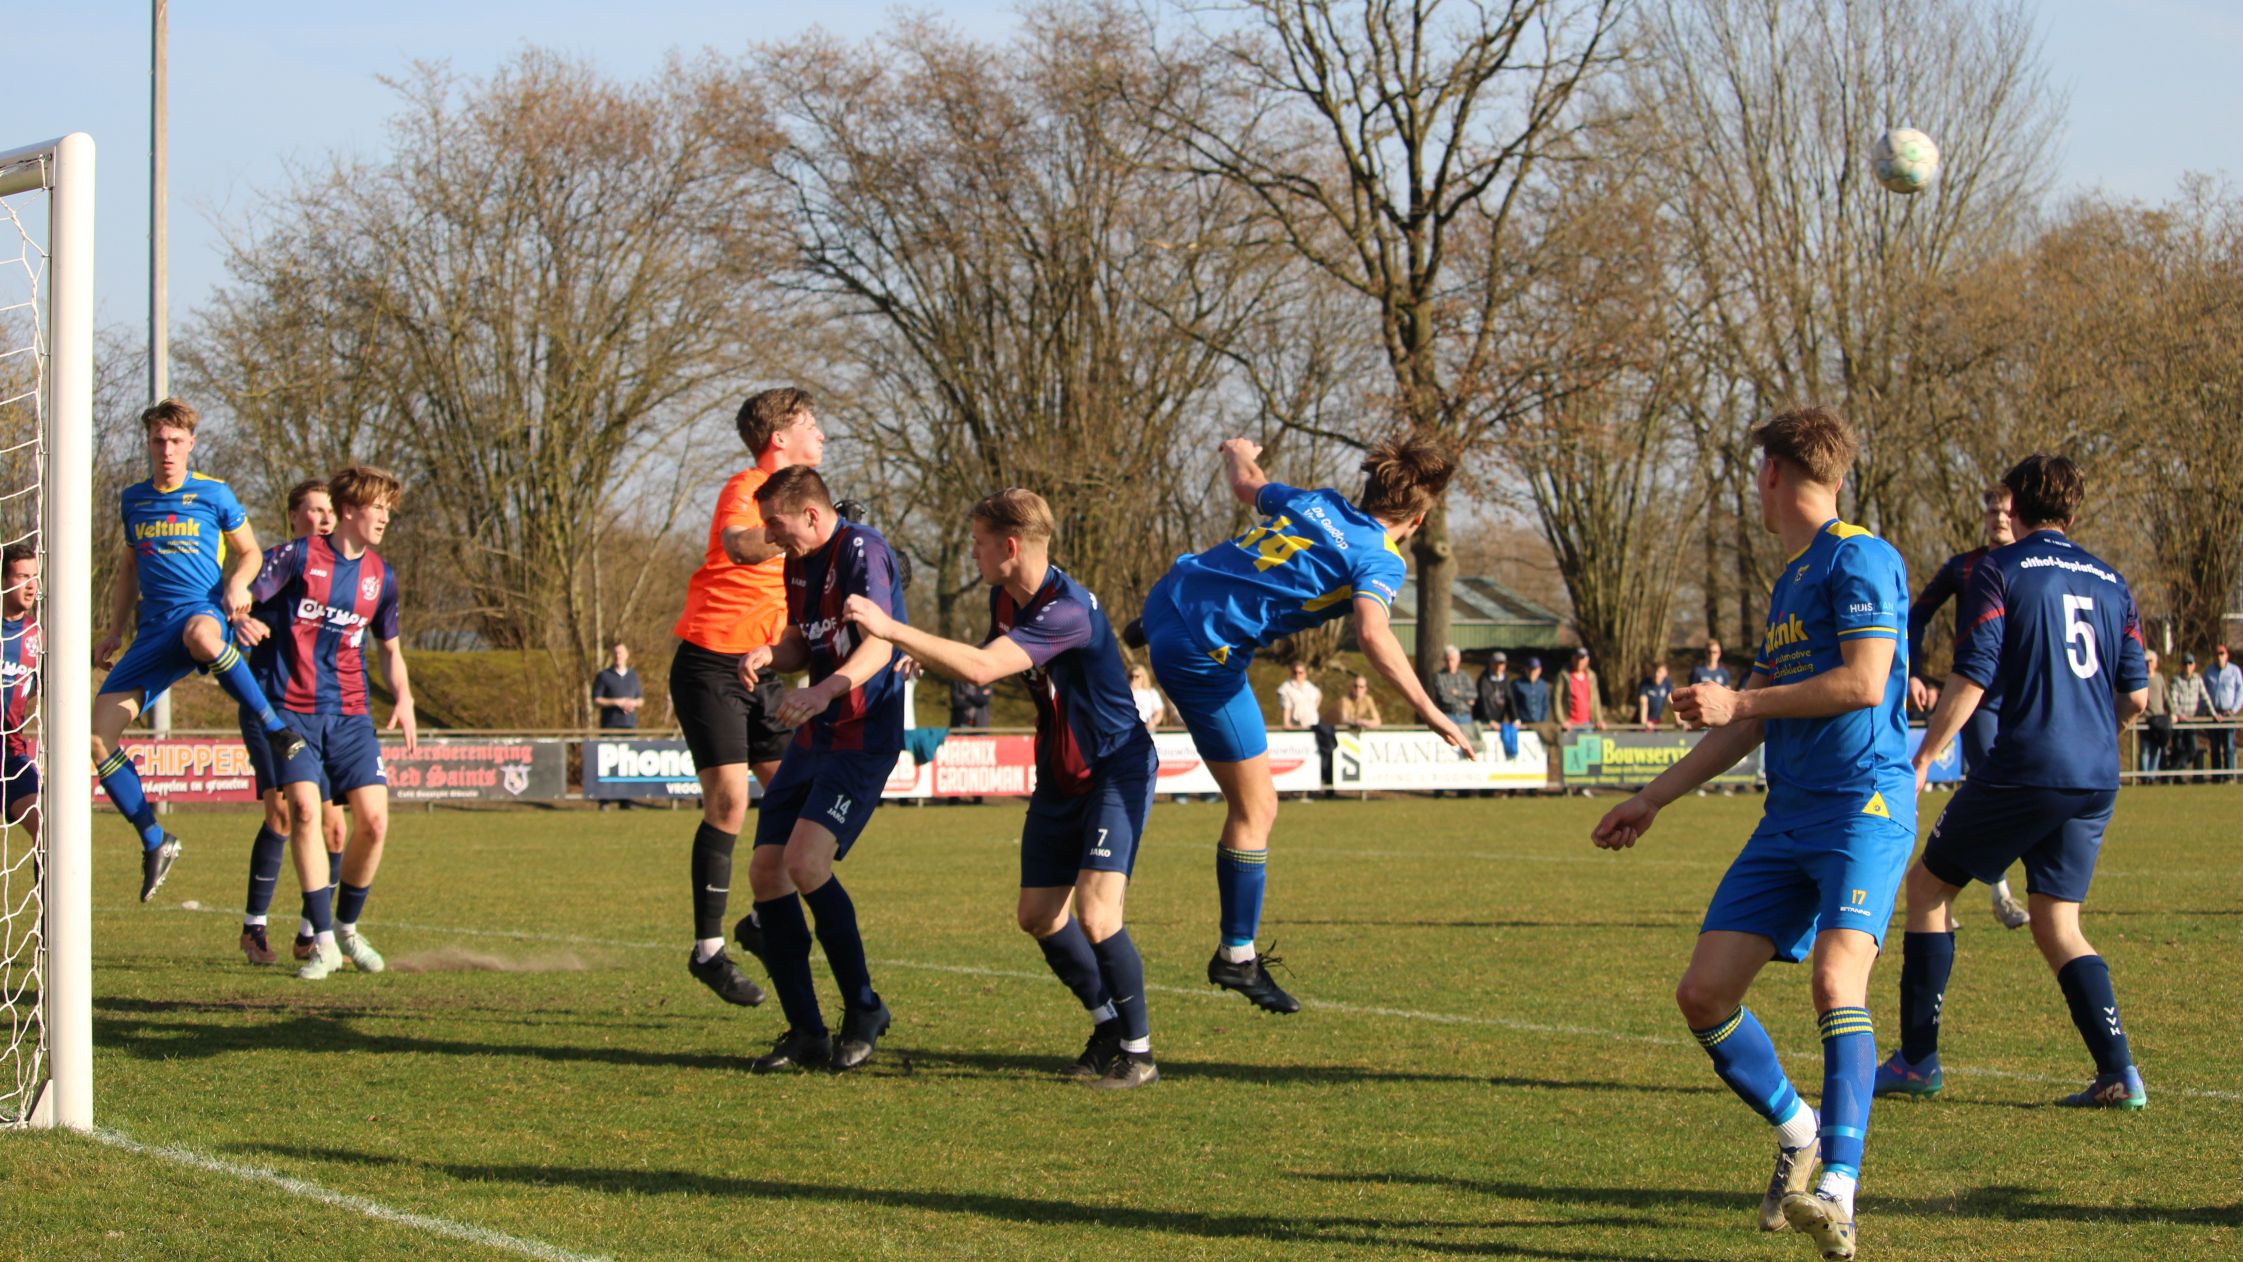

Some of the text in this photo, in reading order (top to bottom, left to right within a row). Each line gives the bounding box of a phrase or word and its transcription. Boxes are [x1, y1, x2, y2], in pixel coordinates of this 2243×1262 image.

[134, 514, 200, 540] Veltink
[2020, 556, 2117, 584] olthof-beplating.nl
[2062, 593, 2099, 679] 5
[91, 743, 256, 776] CHIPPER
[381, 744, 533, 764] portersvereniging
[937, 739, 996, 766] MARNIX
[426, 764, 497, 788] Saints
[937, 765, 1025, 792] GRONDMAN
[826, 807, 846, 824] JAKO
[834, 794, 852, 816] 14
[1097, 828, 1109, 847] 7
[1089, 847, 1111, 858] JAKO
[1852, 889, 1867, 905] 17
